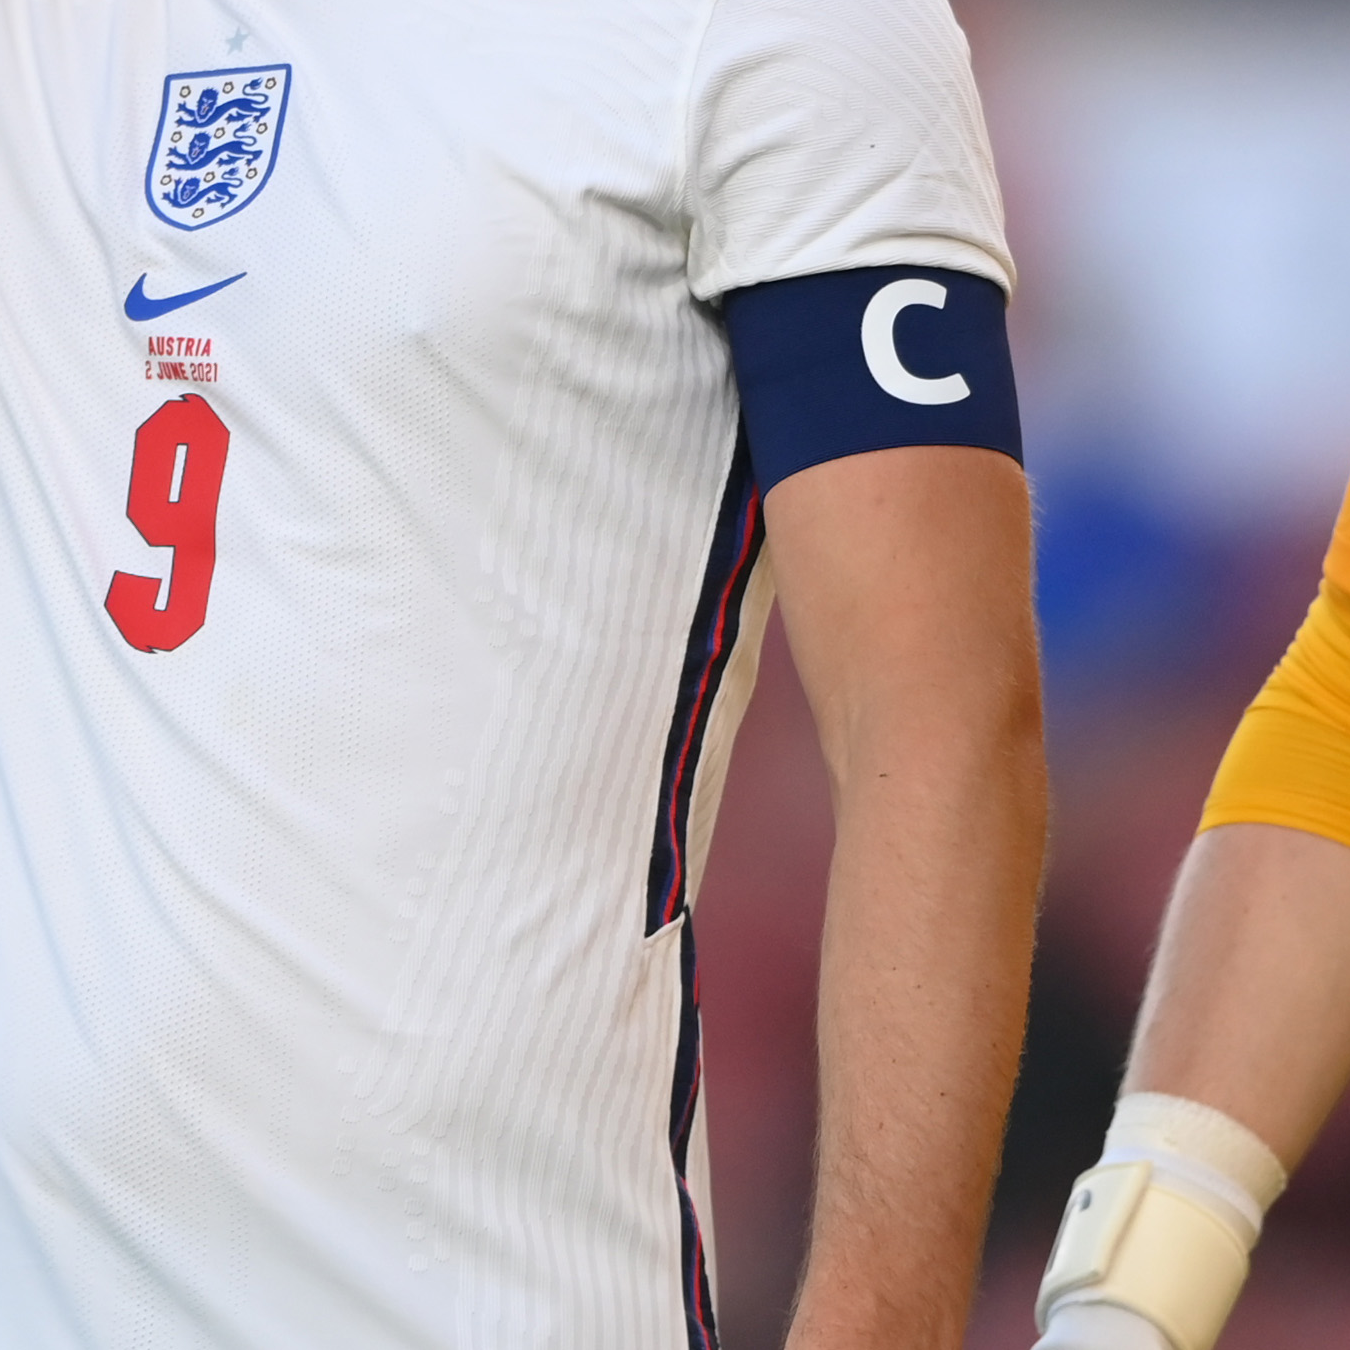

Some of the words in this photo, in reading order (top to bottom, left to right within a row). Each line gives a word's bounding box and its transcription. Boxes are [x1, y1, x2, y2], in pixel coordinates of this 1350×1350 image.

[145, 360, 153, 380] 2
[157, 361, 189, 381] JUNE
[190, 362, 218, 382] 2021
[148, 336, 212, 356] AUSTRIA
[861, 278, 971, 406] C
[104, 392, 230, 653] 9
